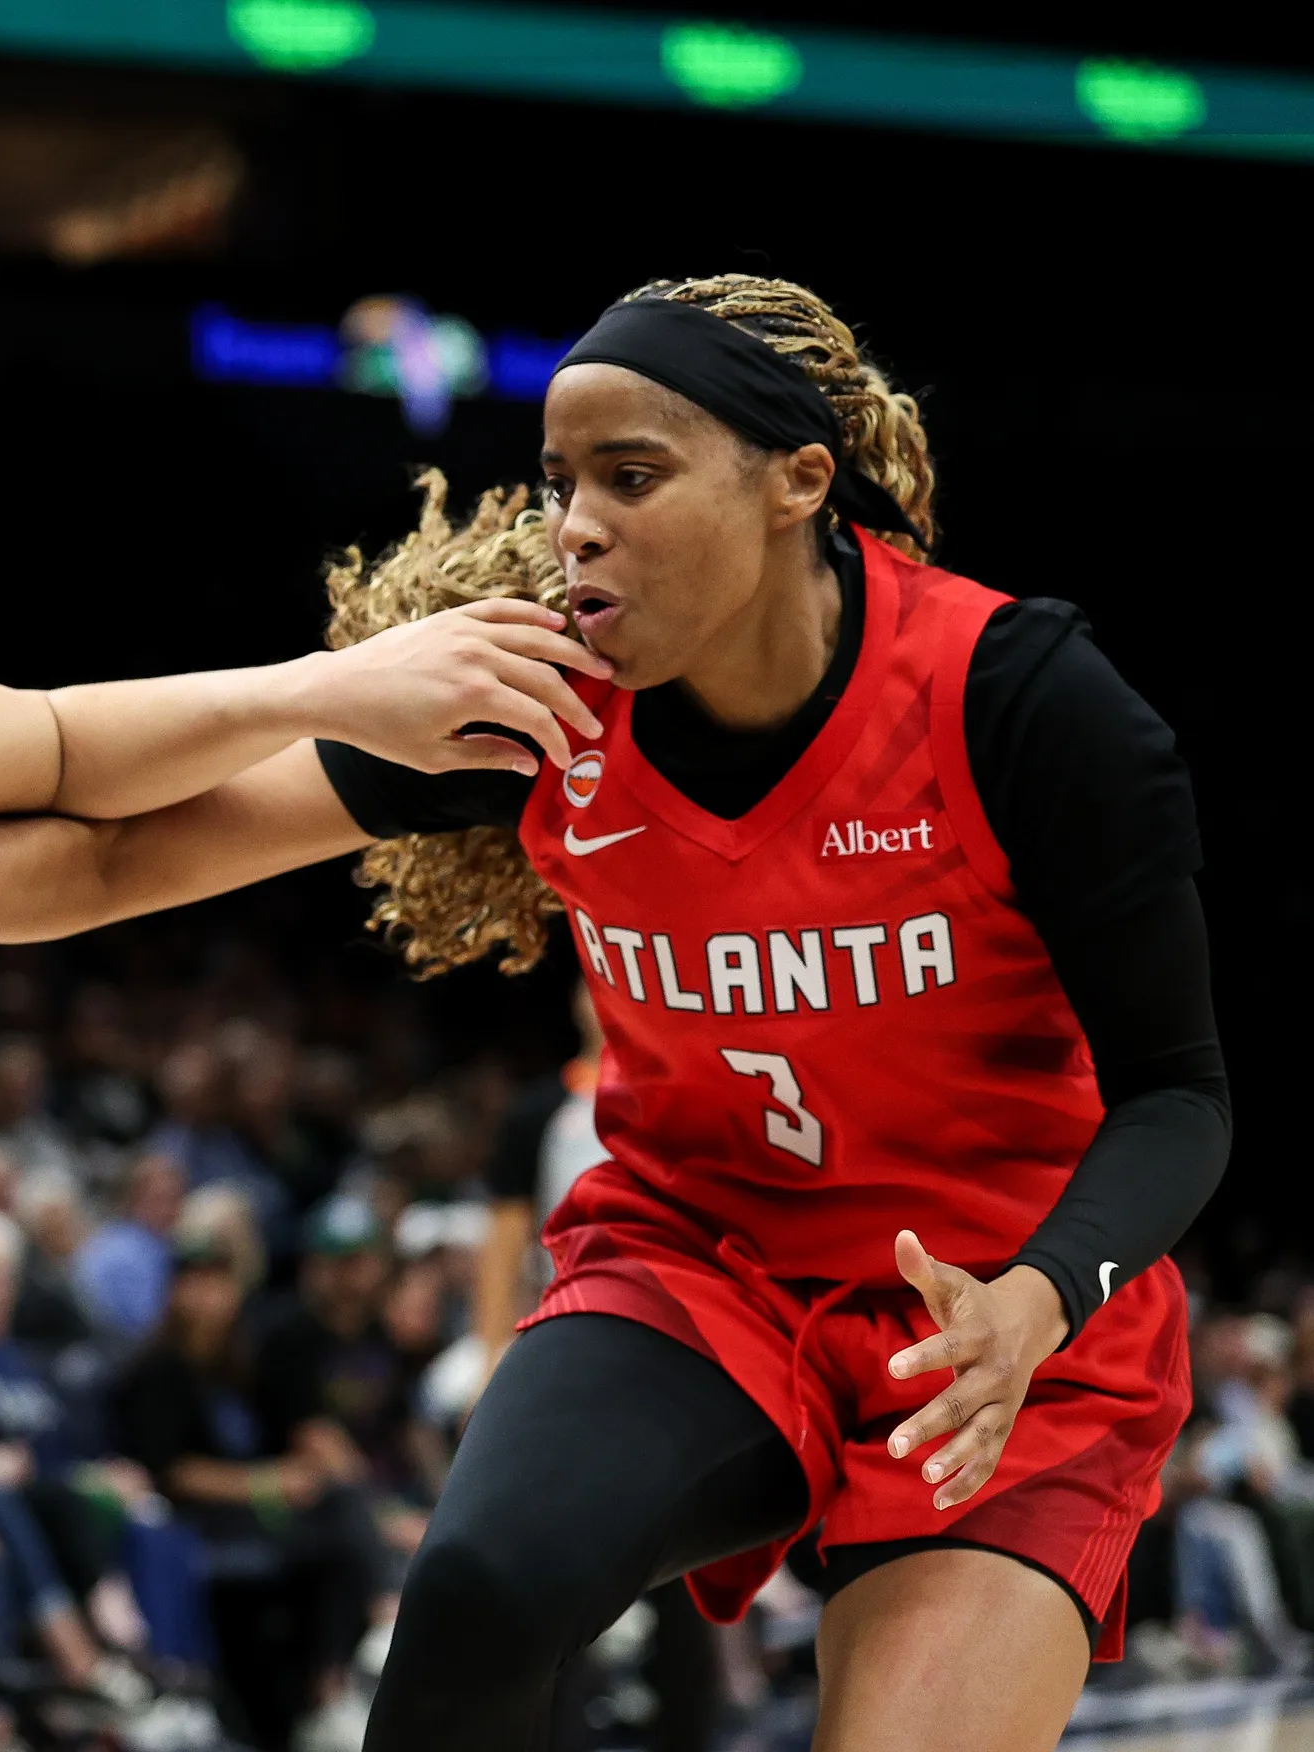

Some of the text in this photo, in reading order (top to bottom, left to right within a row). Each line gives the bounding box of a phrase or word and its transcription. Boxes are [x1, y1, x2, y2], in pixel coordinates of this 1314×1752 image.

[820, 818, 934, 857] Albert
[574, 907, 956, 1015] ATLANTA
[719, 1047, 823, 1168] 3
